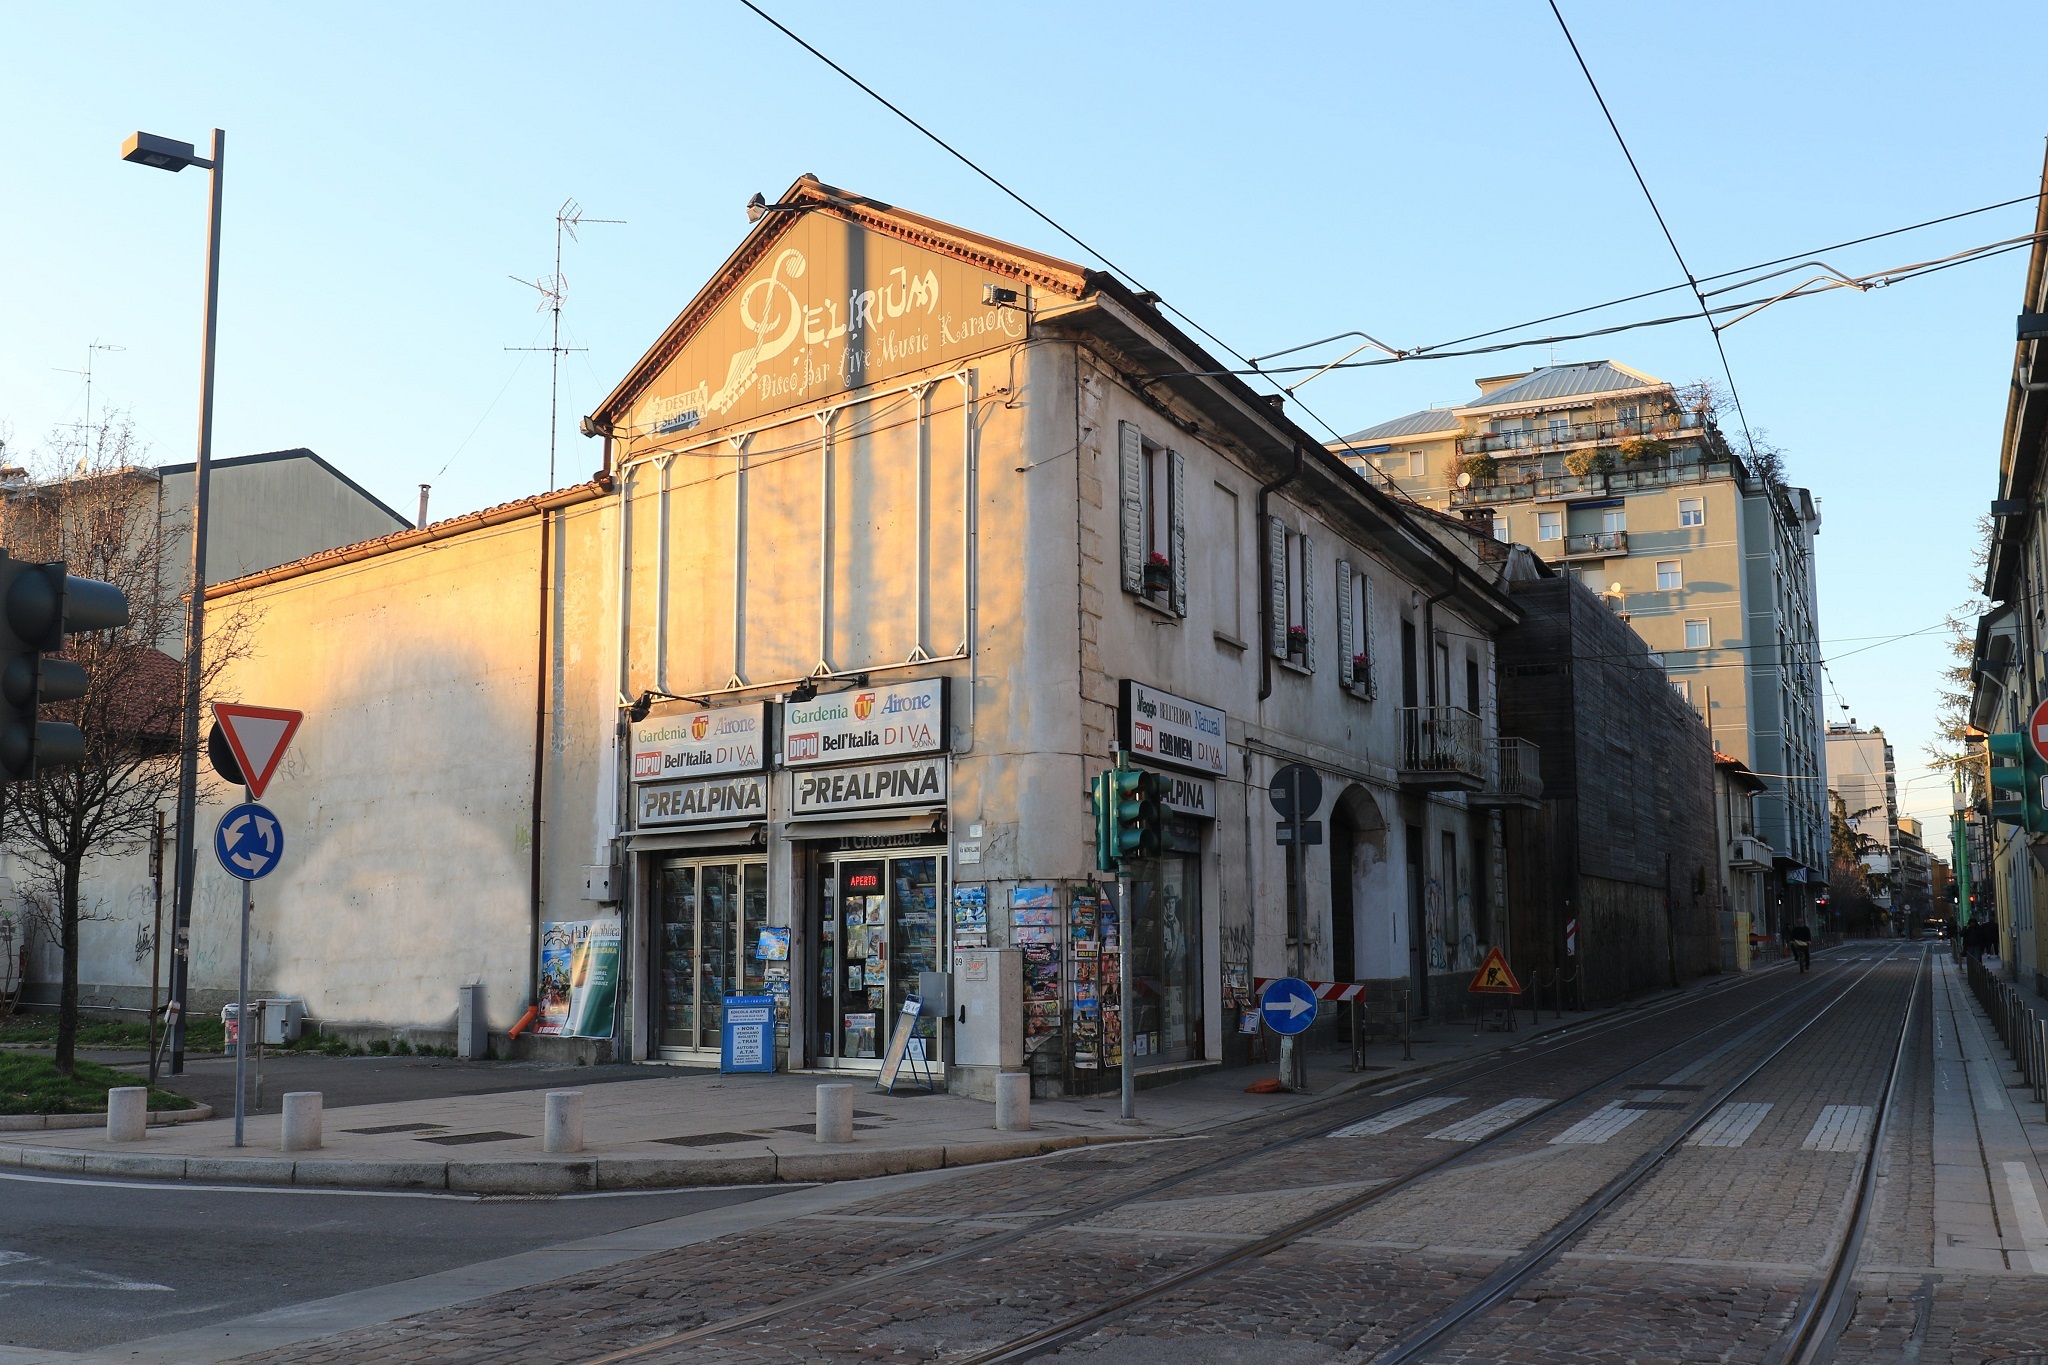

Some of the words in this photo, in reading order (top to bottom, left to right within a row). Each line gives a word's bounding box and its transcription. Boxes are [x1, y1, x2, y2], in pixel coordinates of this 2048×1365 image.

[758, 372, 798, 401] Disco
[797, 349, 830, 396] Bar
[877, 327, 929, 368] Music
[666, 389, 704, 412] DESTRA
[791, 705, 849, 725] Gardenia
[880, 693, 932, 715] Airone
[638, 726, 687, 744] Gardenia
[714, 717, 756, 736] Airone
[822, 730, 880, 751] Bell'Italia
[664, 749, 713, 769] Bell'Italia
[801, 766, 940, 805] PREALPINA
[645, 783, 762, 818] PREALPINA
[850, 875, 877, 887] APERTO
